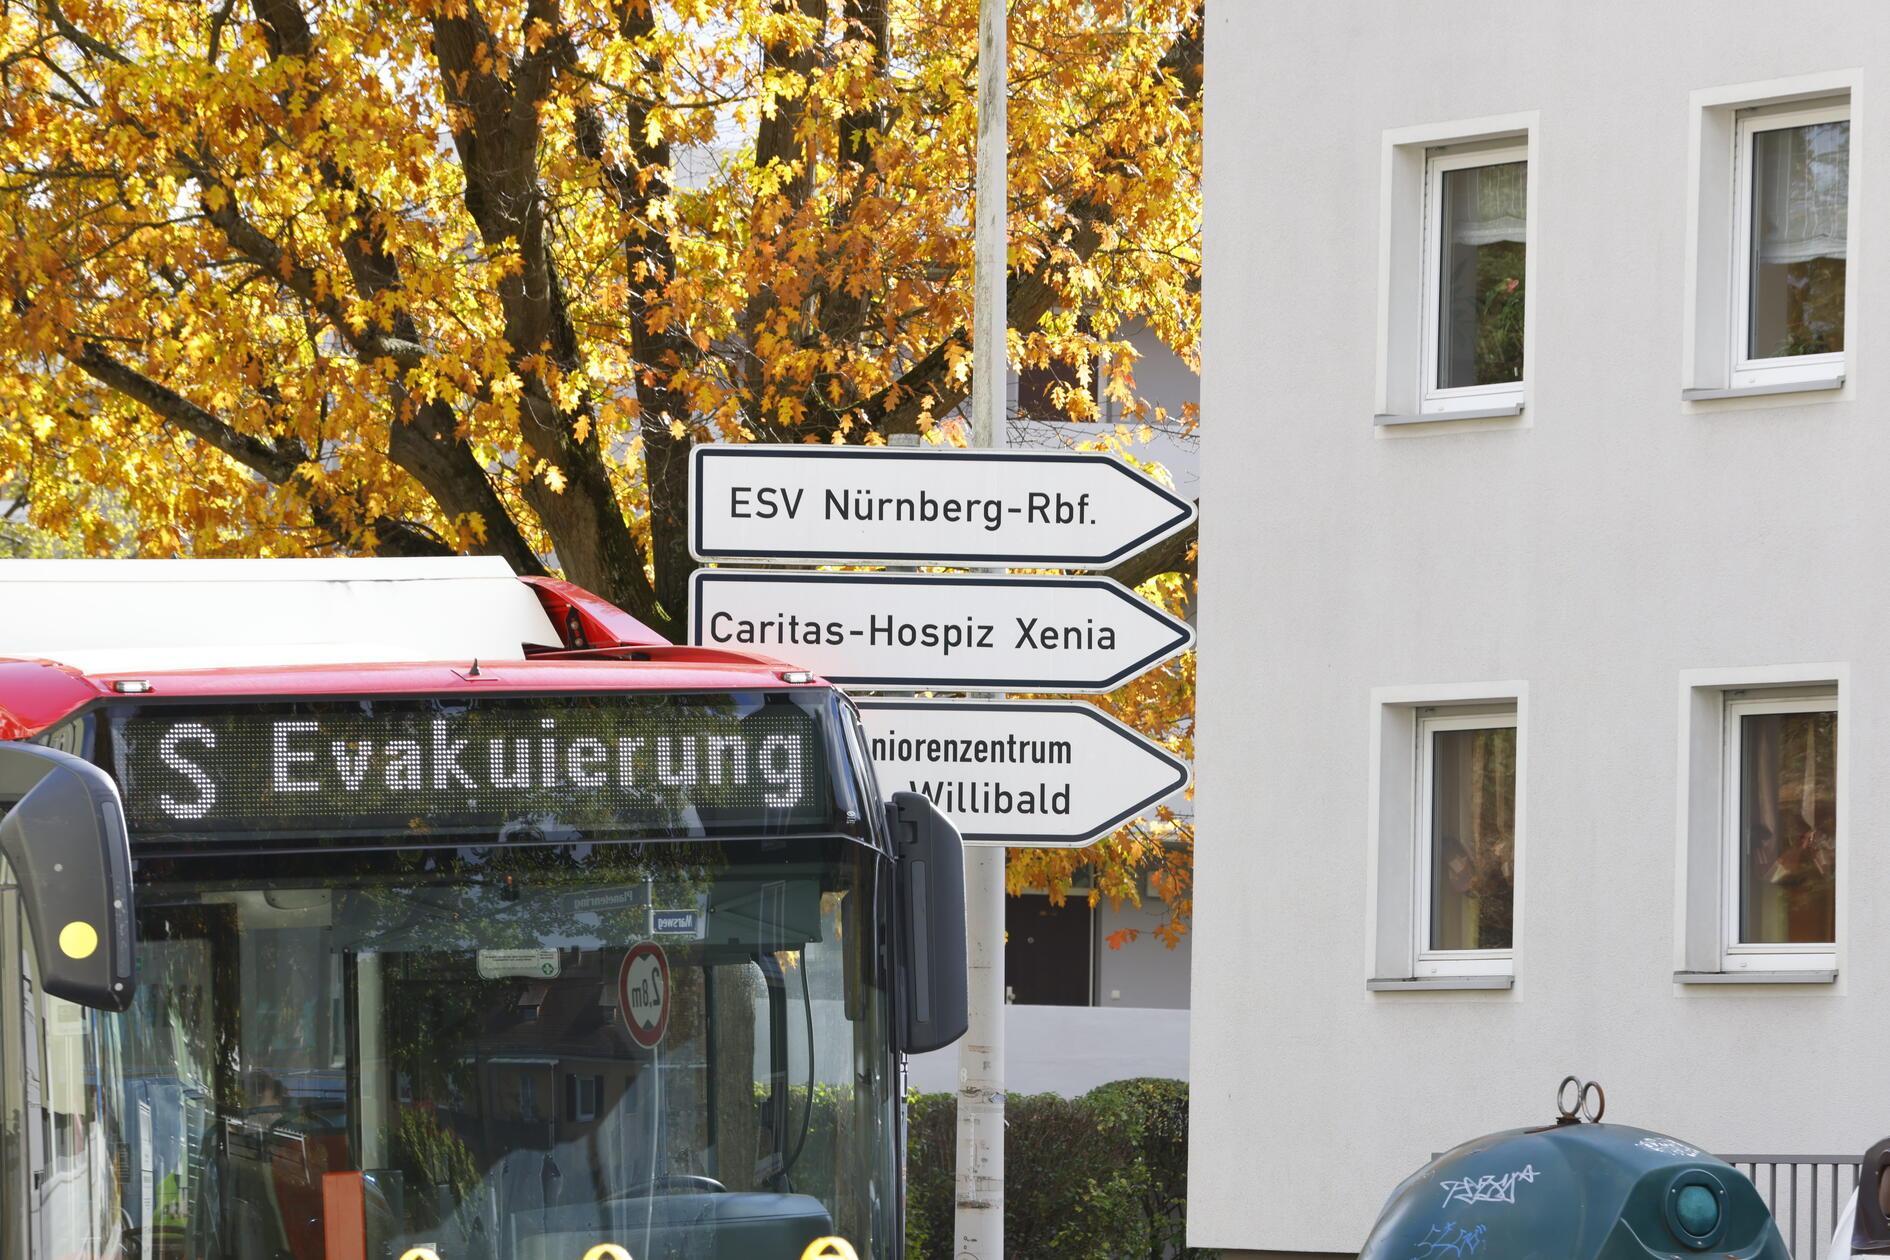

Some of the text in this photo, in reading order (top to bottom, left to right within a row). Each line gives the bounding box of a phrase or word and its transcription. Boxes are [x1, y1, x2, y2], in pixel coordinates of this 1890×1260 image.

[729, 486, 1097, 532] ESV Nürnberg-Rbf.
[710, 611, 1117, 656] Caritas-Hospiz Xenia
[160, 717, 802, 819] S Evakuierung
[872, 729, 1073, 764] niorenzentrum
